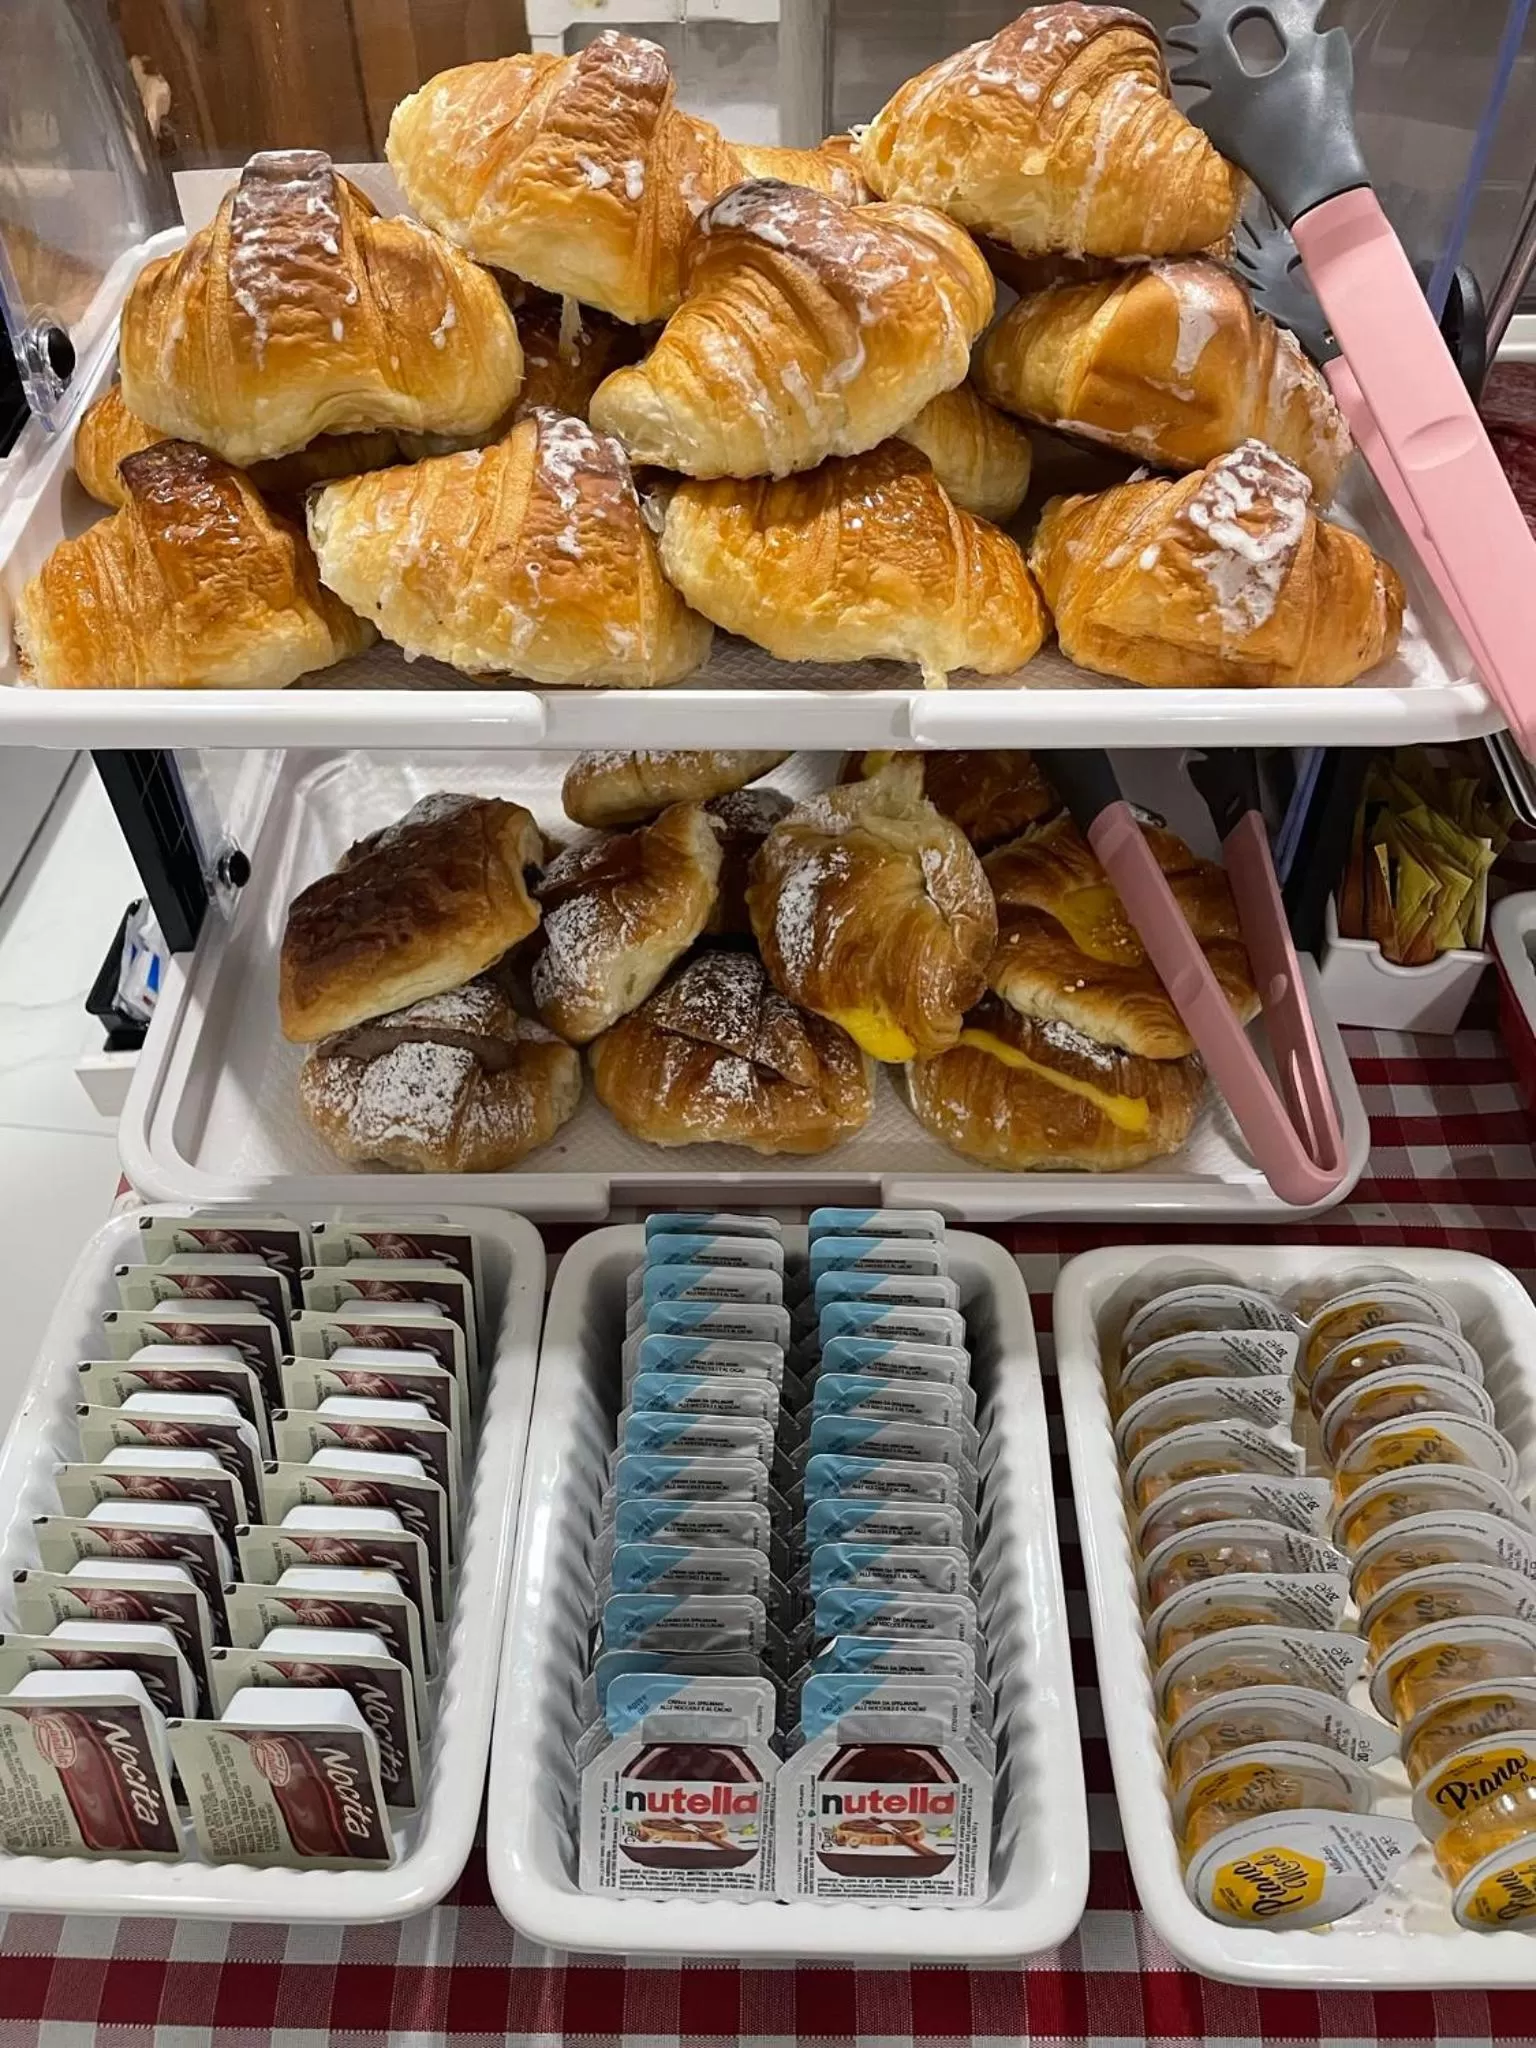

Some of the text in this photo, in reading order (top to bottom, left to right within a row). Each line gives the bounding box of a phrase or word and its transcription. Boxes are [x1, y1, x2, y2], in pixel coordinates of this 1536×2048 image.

[97, 1719, 160, 1826] Nocita
[314, 1747, 374, 1839] Nocita
[625, 1785, 759, 1815] nutella
[1435, 1755, 1529, 1810] Piana
[822, 1786, 955, 1815] nutella
[1232, 1860, 1304, 1916] Piana
[1255, 1853, 1310, 1889] Miele
